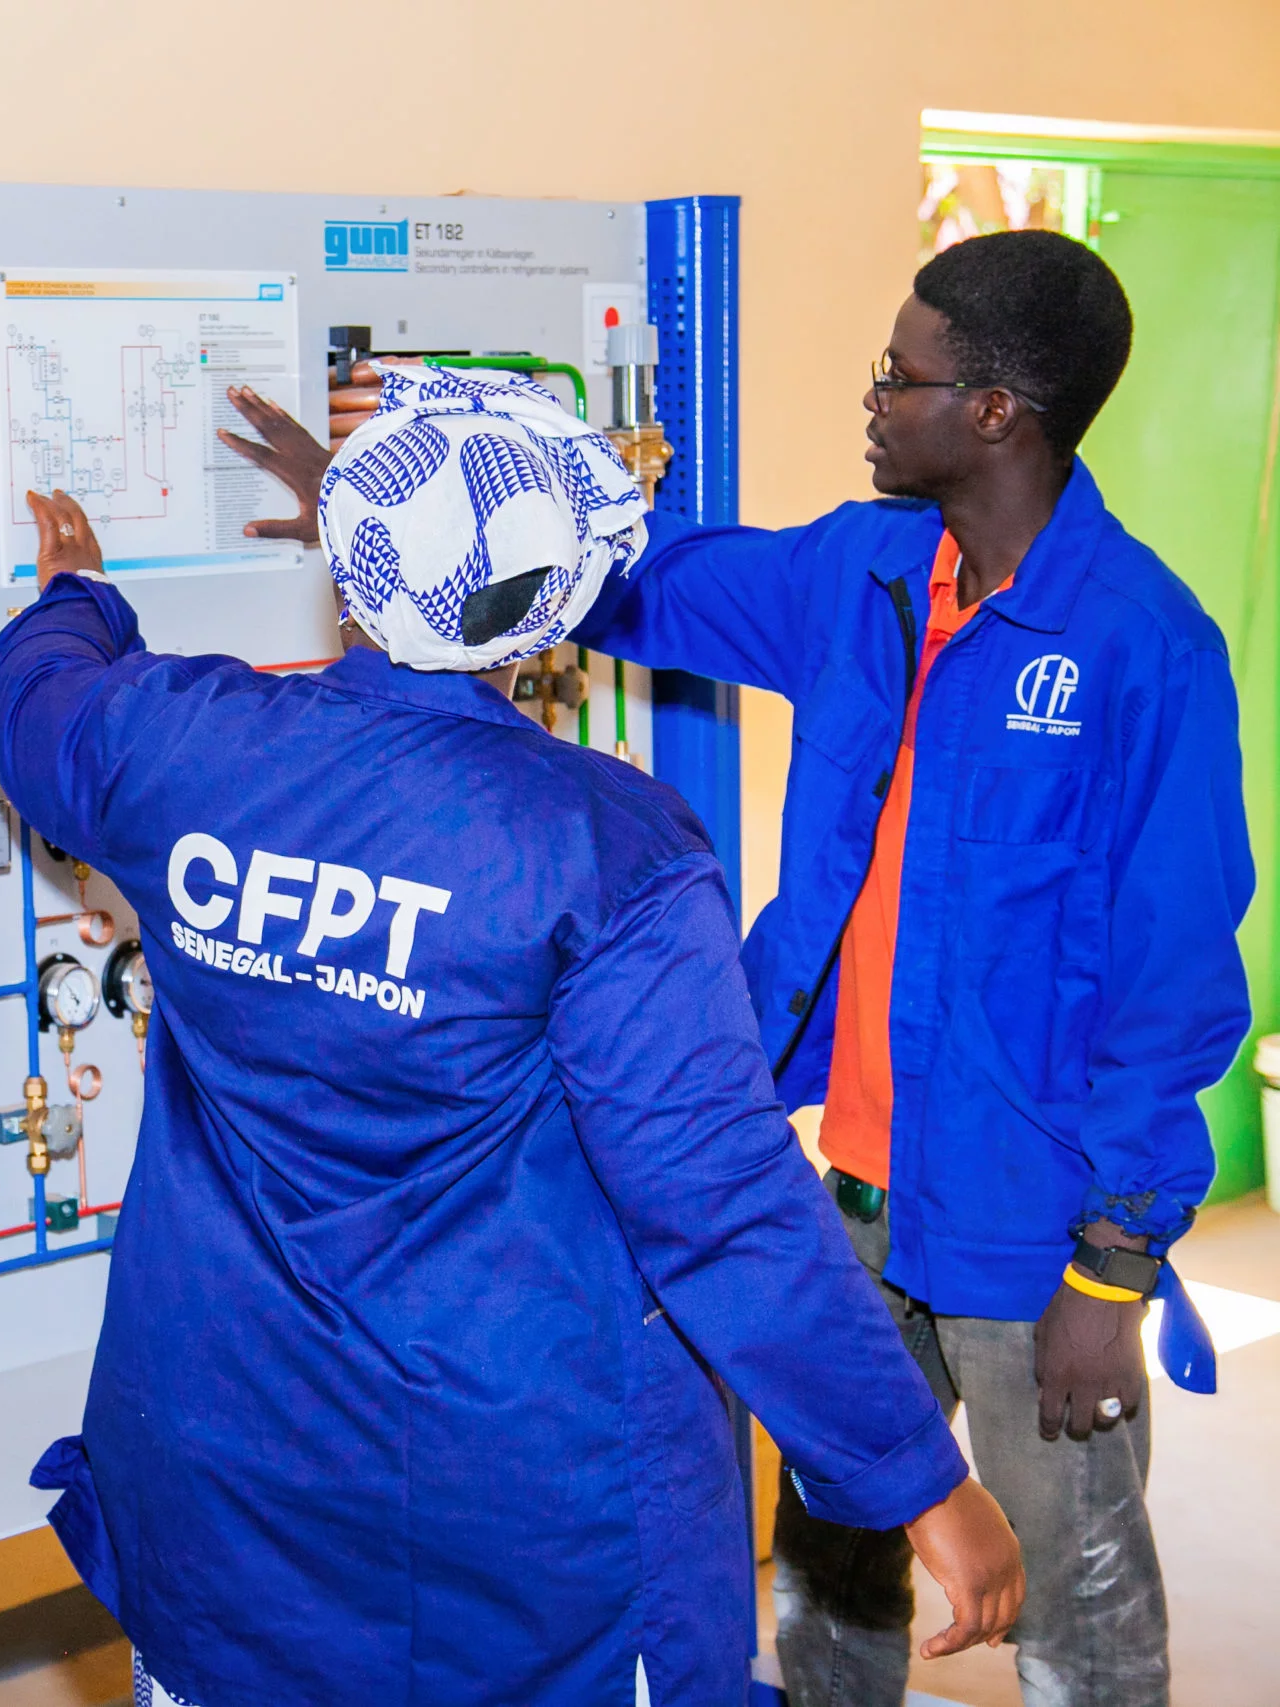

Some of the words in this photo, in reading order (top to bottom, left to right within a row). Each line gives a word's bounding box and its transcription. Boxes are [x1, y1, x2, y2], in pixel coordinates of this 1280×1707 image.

[324, 218, 409, 266] gunt
[414, 222, 431, 240] ET
[435, 223, 464, 241] 182
[167, 832, 452, 979] CFPT
